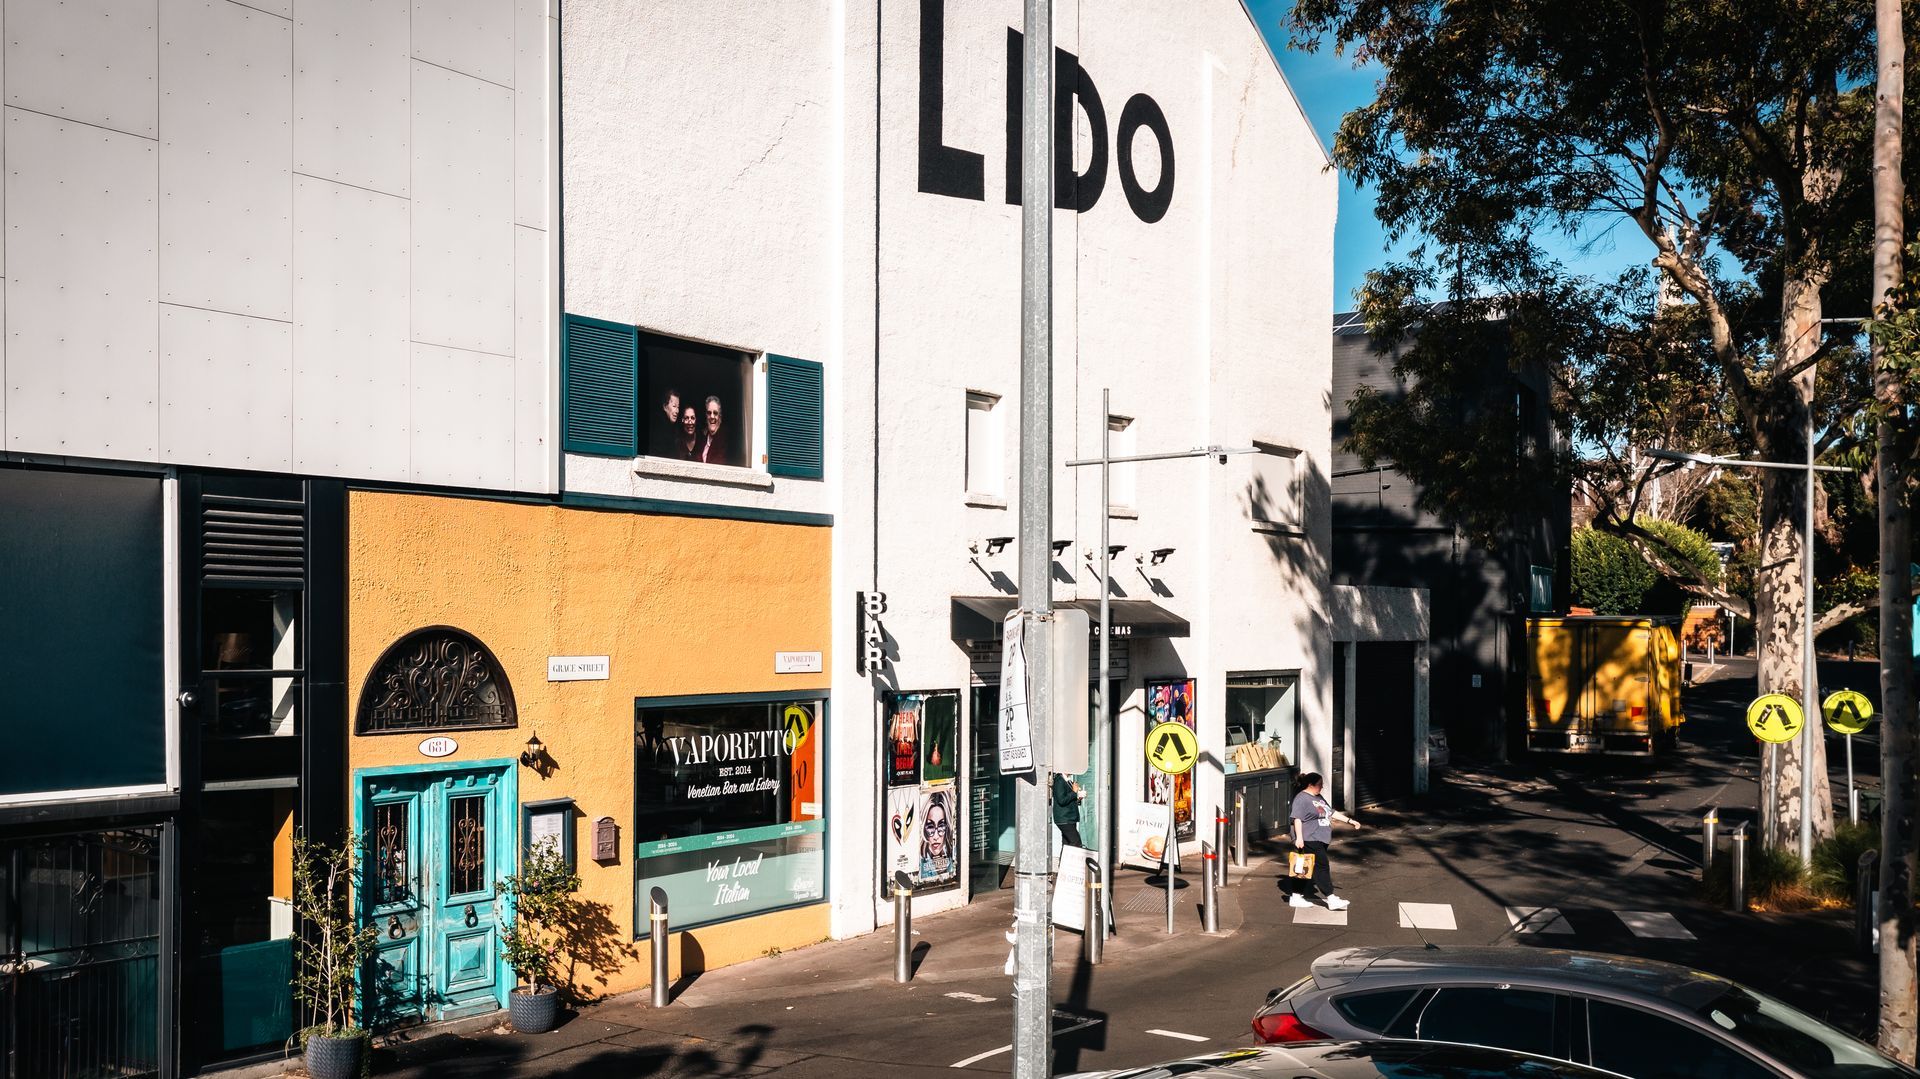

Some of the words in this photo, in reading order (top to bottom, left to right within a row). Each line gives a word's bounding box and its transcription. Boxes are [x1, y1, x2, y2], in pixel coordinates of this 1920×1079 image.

[918, 0, 1175, 224] LIDO
[865, 591, 887, 670] BAR
[1094, 626, 1132, 635] CEMAS
[552, 663, 577, 673] GRACE
[578, 663, 605, 672] STREET
[1005, 707, 1015, 731] 2P
[428, 740, 448, 753] 681
[669, 728, 797, 766] VAPORETTO
[718, 767, 734, 777] EST.
[735, 765, 752, 776] 2014
[687, 785, 721, 799] Venetian
[722, 781, 738, 795] Bar
[739, 779, 754, 792] and
[755, 777, 781, 795] Eatery
[706, 859, 729, 883] Your
[732, 852, 764, 878] Local
[713, 880, 751, 906] Italian
